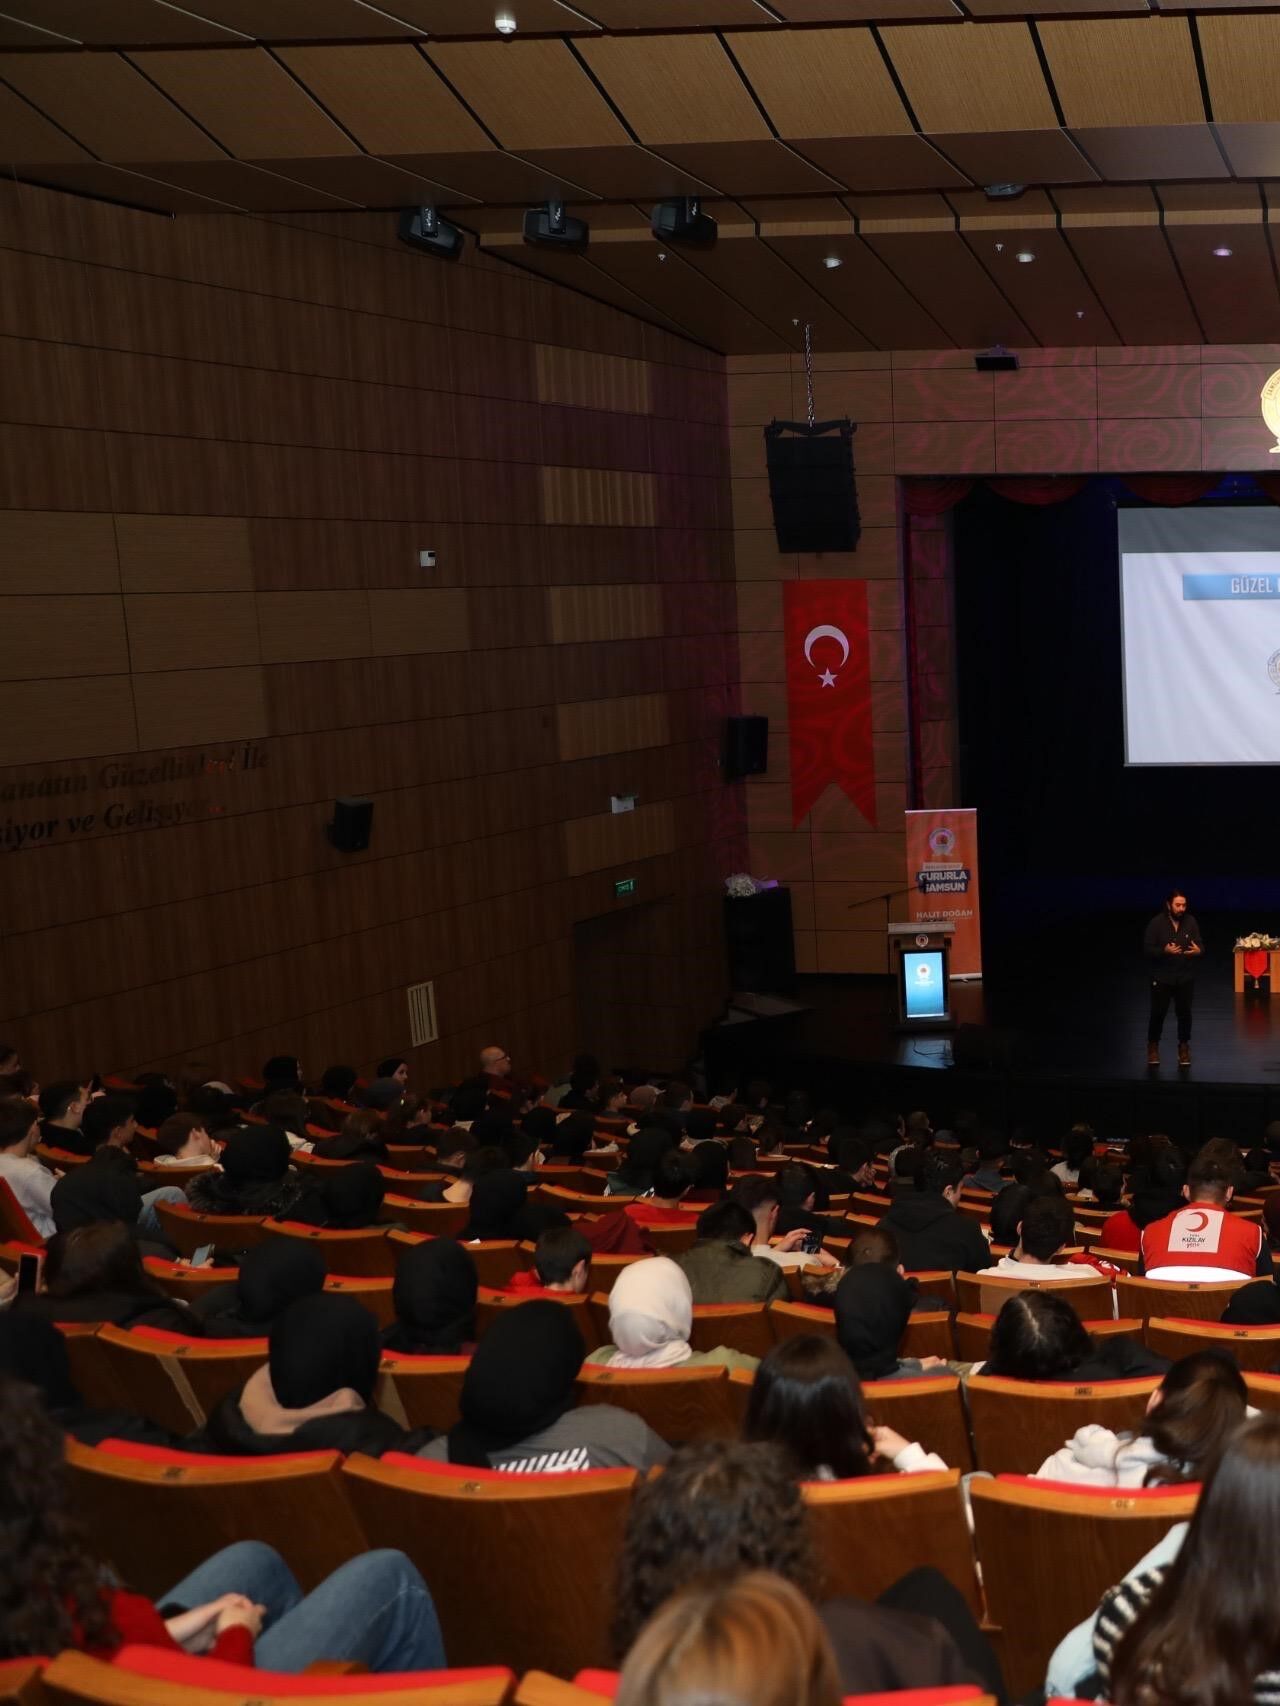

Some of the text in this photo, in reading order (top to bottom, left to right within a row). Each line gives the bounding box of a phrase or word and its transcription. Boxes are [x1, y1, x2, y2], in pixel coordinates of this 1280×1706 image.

[1231, 575, 1273, 593] GÜZEL
[0, 816, 59, 851] iyor
[67, 813, 96, 833] ve
